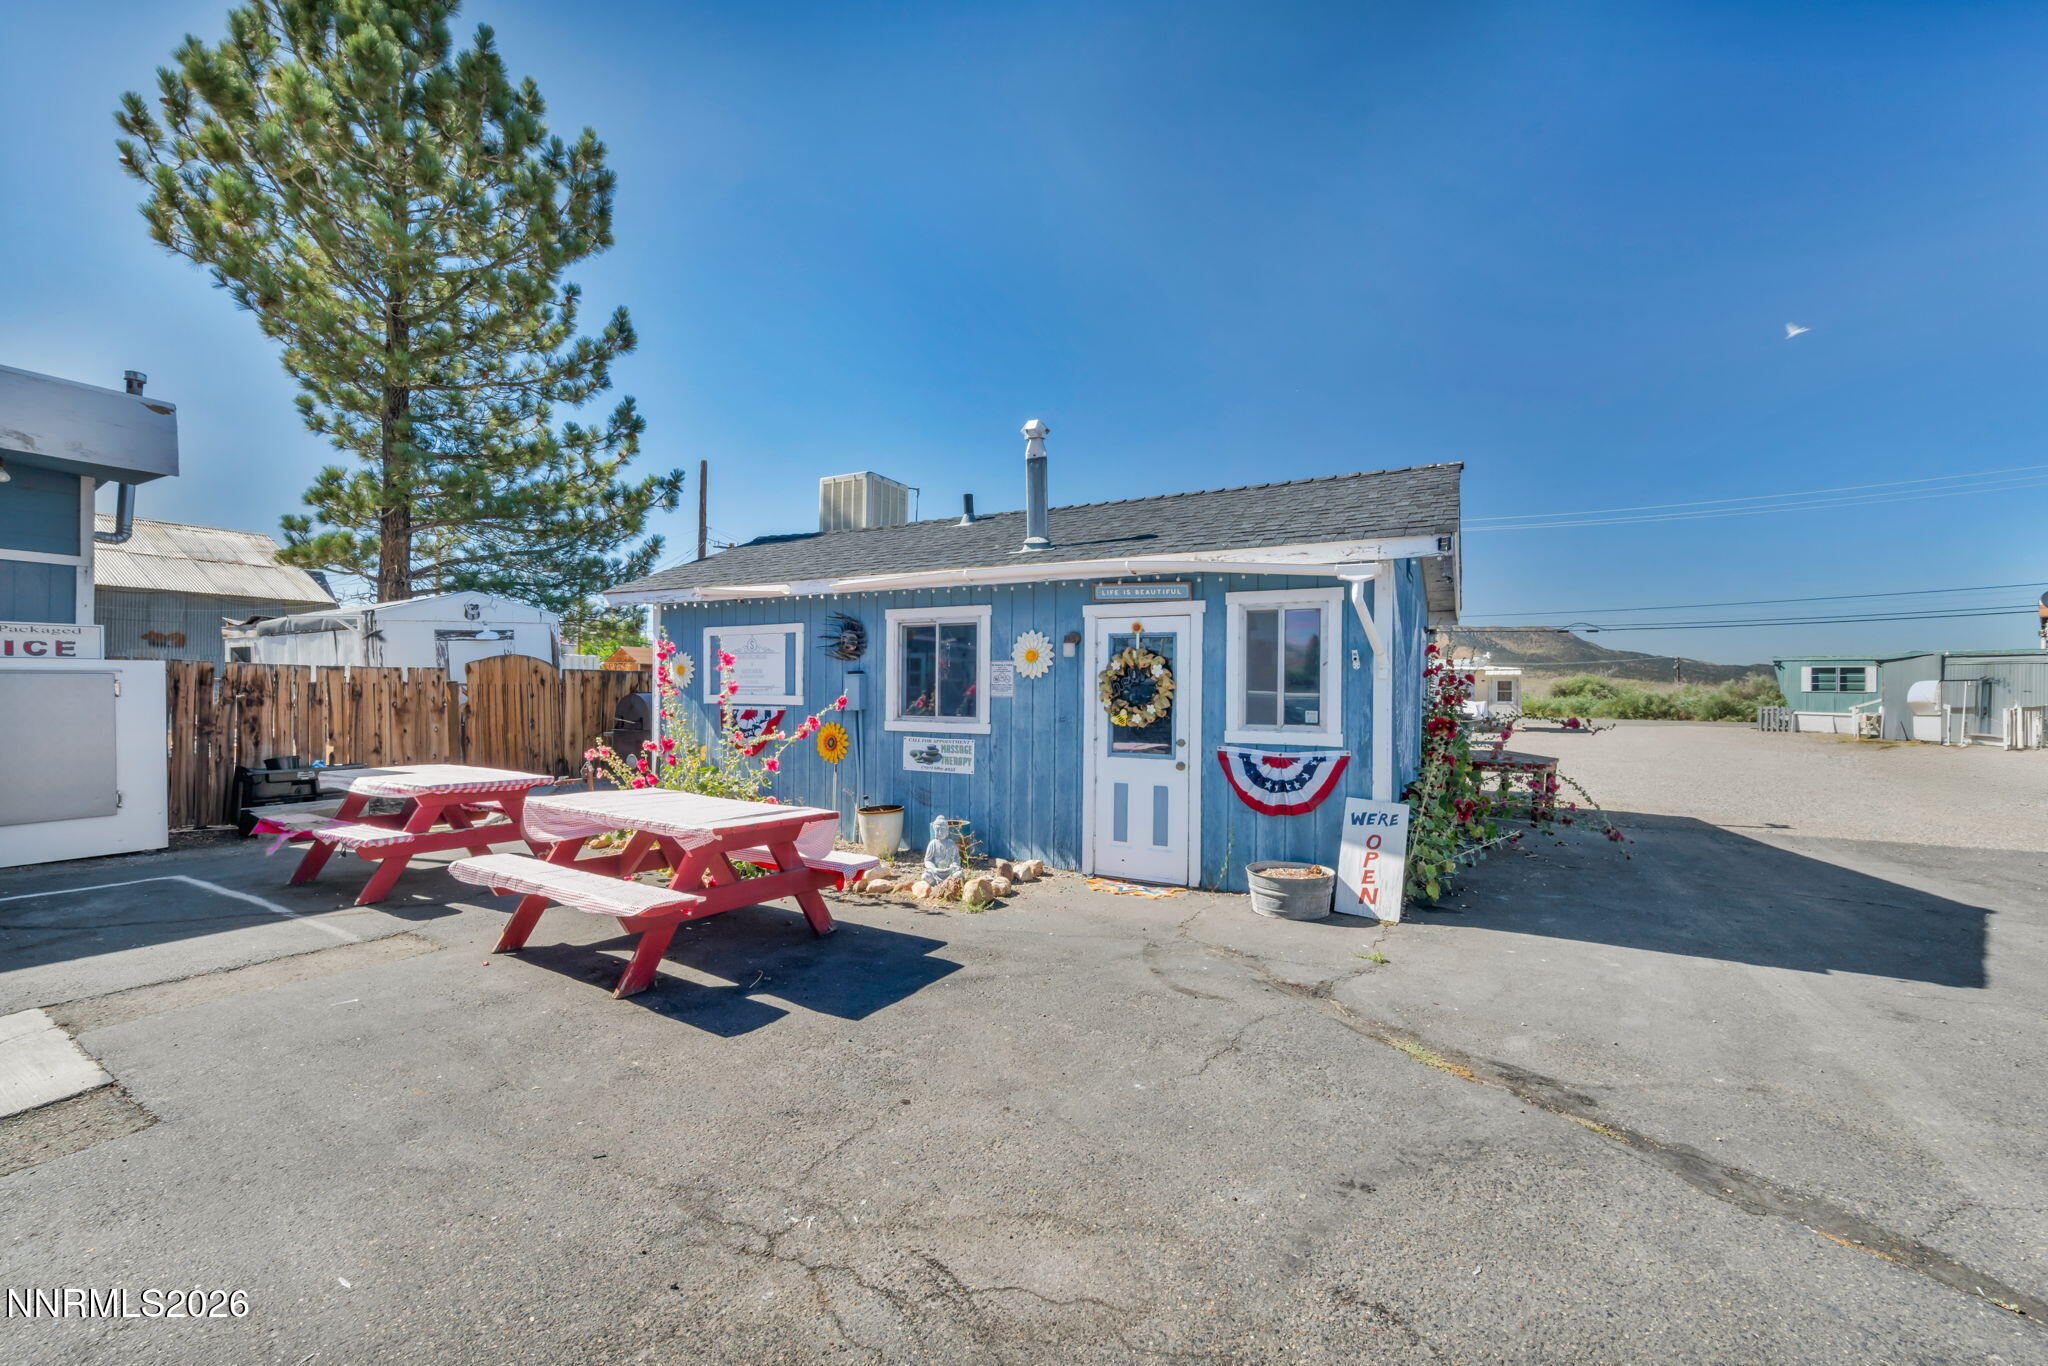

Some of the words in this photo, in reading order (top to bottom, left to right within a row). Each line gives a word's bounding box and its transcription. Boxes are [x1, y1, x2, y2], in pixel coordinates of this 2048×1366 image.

[1101, 588, 1119, 596] LIFE
[1123, 588, 1131, 596] IS
[1135, 588, 1182, 596] BEAUTIFUL
[0, 625, 81, 635] Packaged
[4, 639, 77, 657] ICE
[941, 744, 972, 754] MASSAGE
[941, 756, 972, 766] THERAPY
[1351, 811, 1399, 827] WE'RE
[1358, 833, 1382, 906] OPEN
